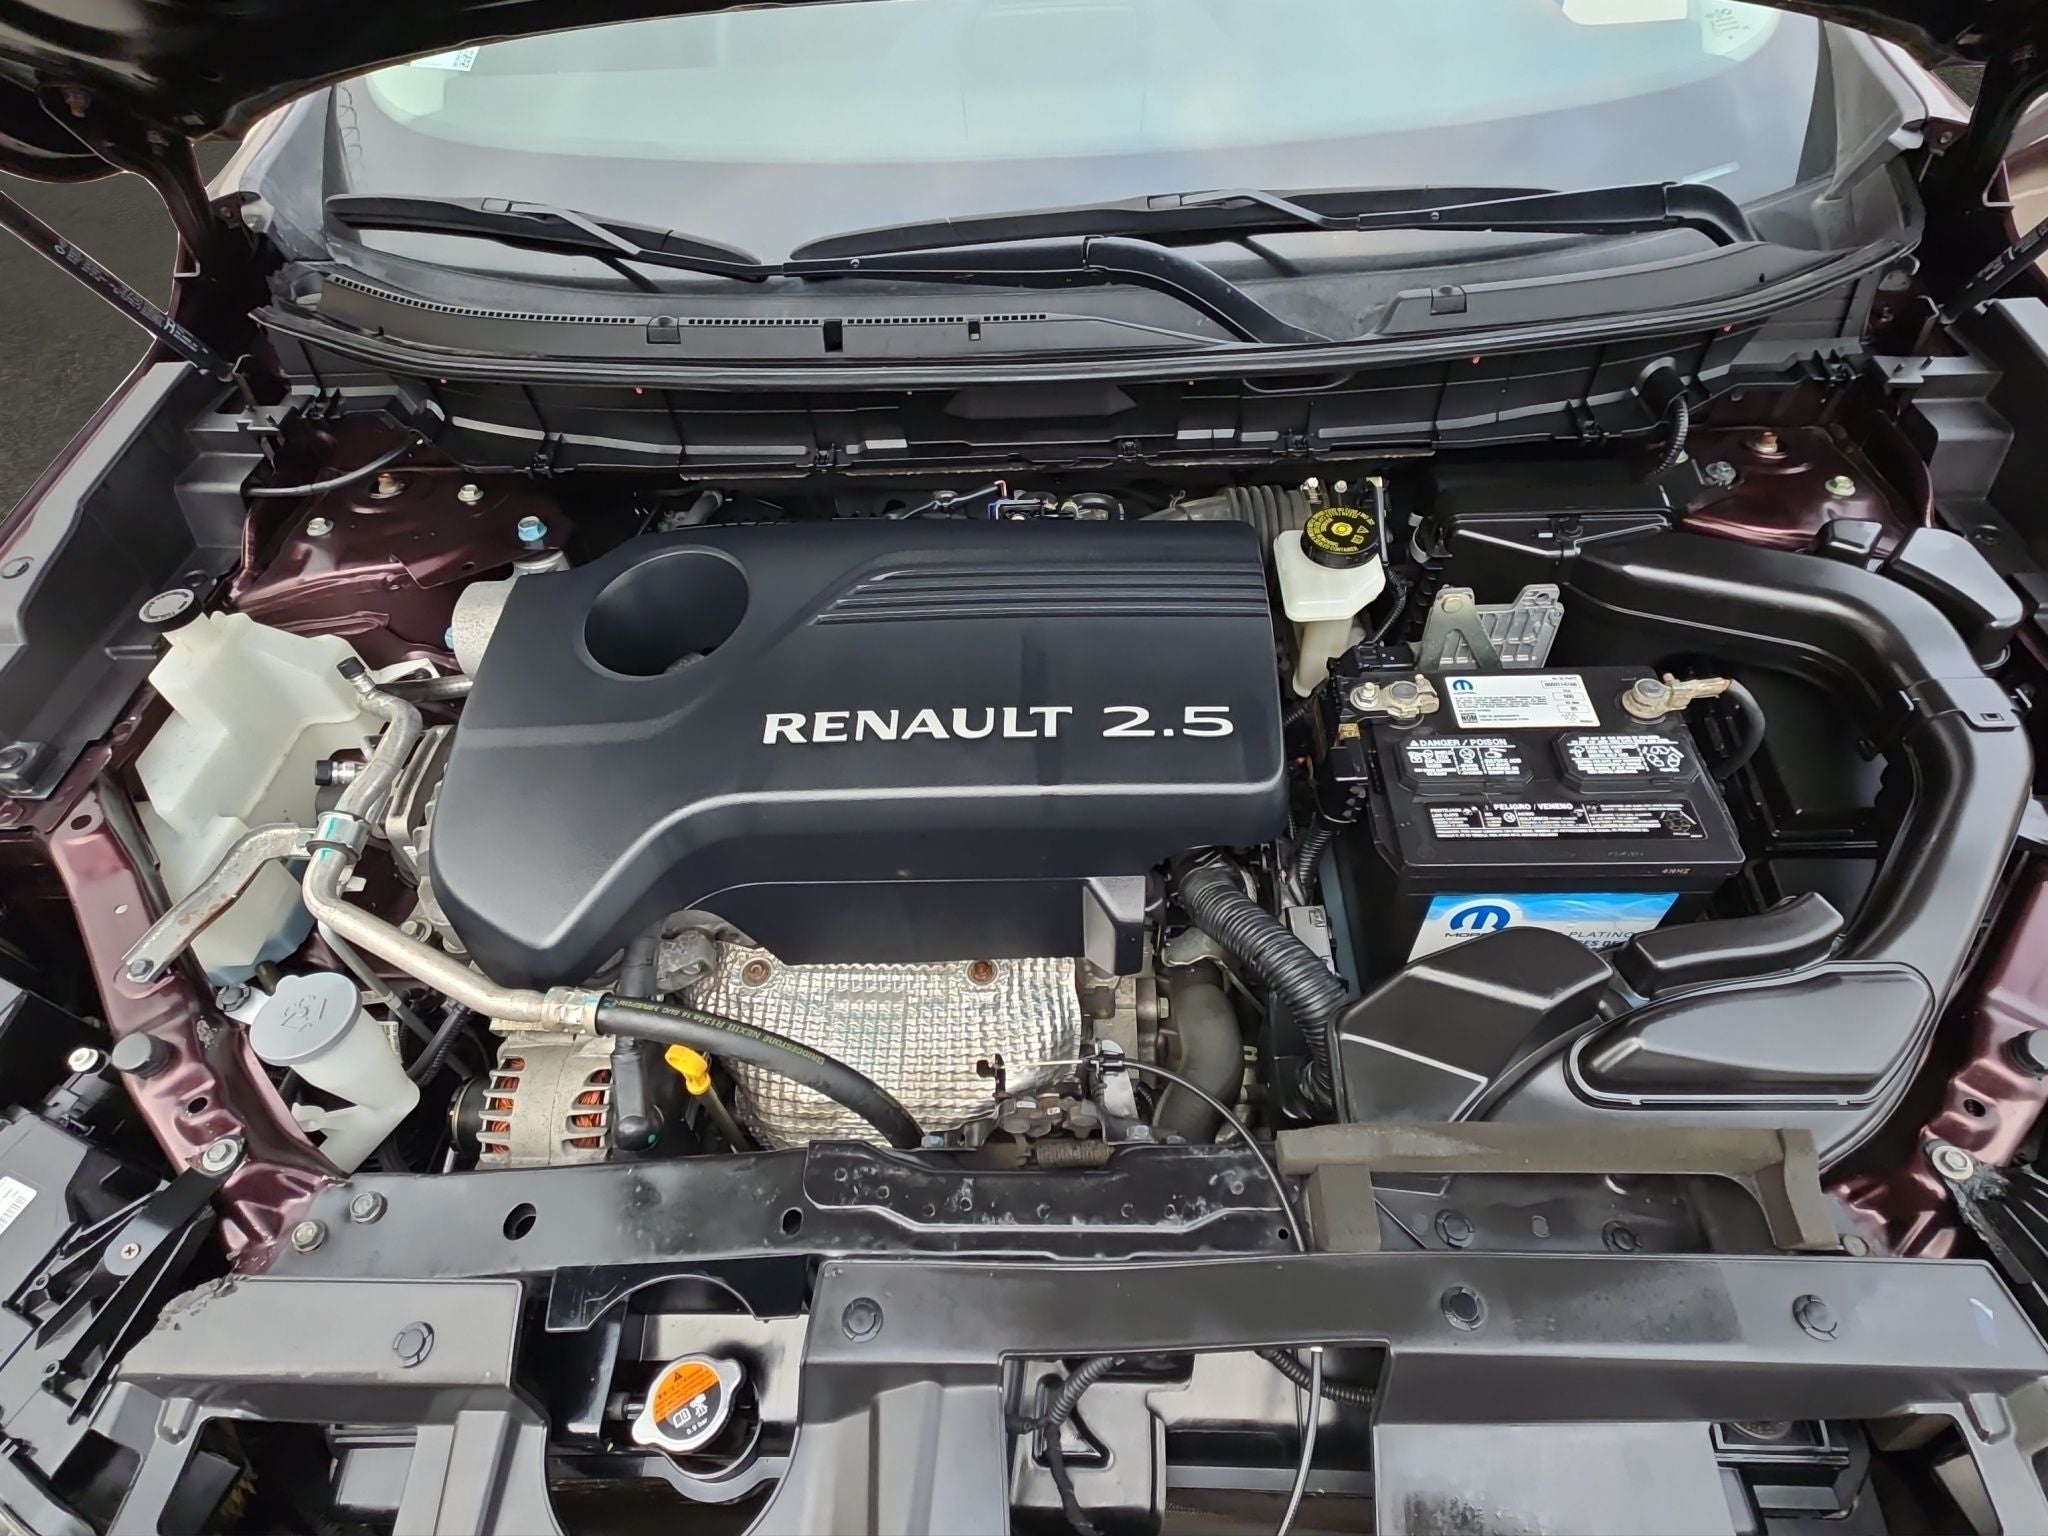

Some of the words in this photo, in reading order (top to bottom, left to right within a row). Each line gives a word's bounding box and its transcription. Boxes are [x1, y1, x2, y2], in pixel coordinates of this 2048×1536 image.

[763, 706, 1073, 744] RENAULT
[1102, 705, 1234, 738] 2.5
[1419, 738, 1460, 747] DANGER
[1469, 738, 1508, 746] POISON
[1537, 802, 1574, 810] VENENO
[693, 1015, 725, 1030] R134a
[763, 1036, 825, 1065] BRIDGESTONE
[697, 1418, 708, 1428] bar
